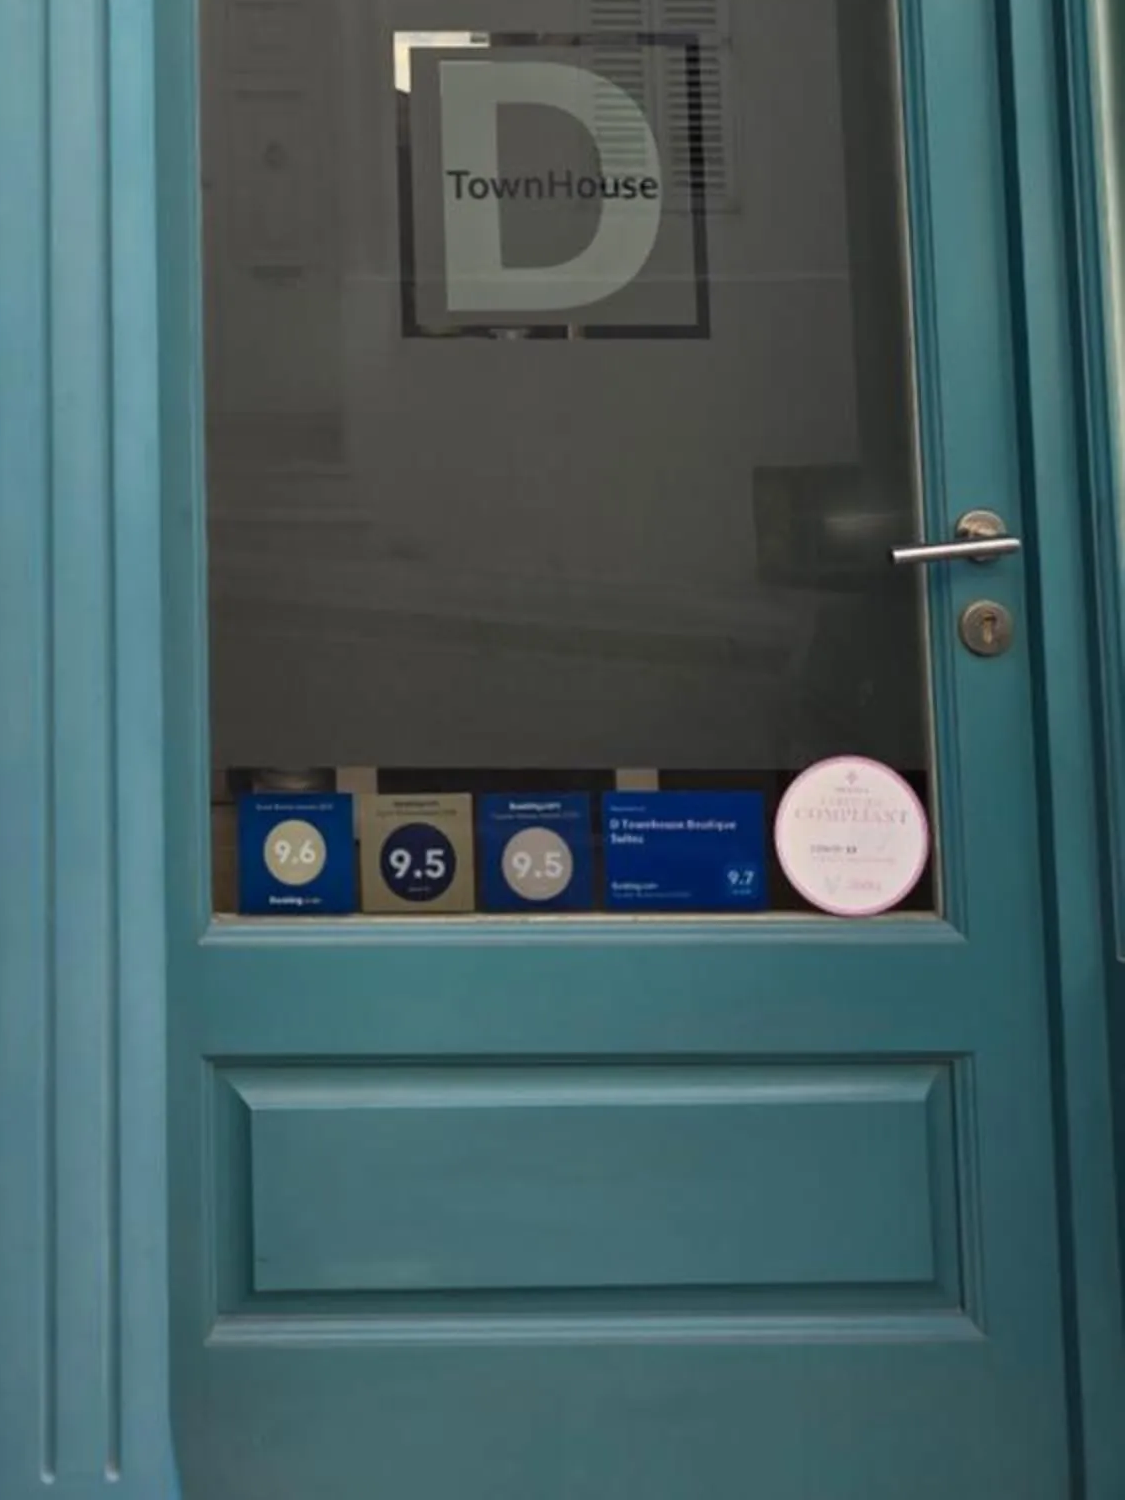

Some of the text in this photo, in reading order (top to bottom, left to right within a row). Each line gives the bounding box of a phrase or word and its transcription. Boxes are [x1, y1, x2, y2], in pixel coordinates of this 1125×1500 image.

[439, 60, 663, 312] D
[446, 169, 660, 201] TownHouse
[274, 840, 316, 864] 9.6
[389, 848, 446, 879] 9.5
[512, 851, 563, 878] 9.5
